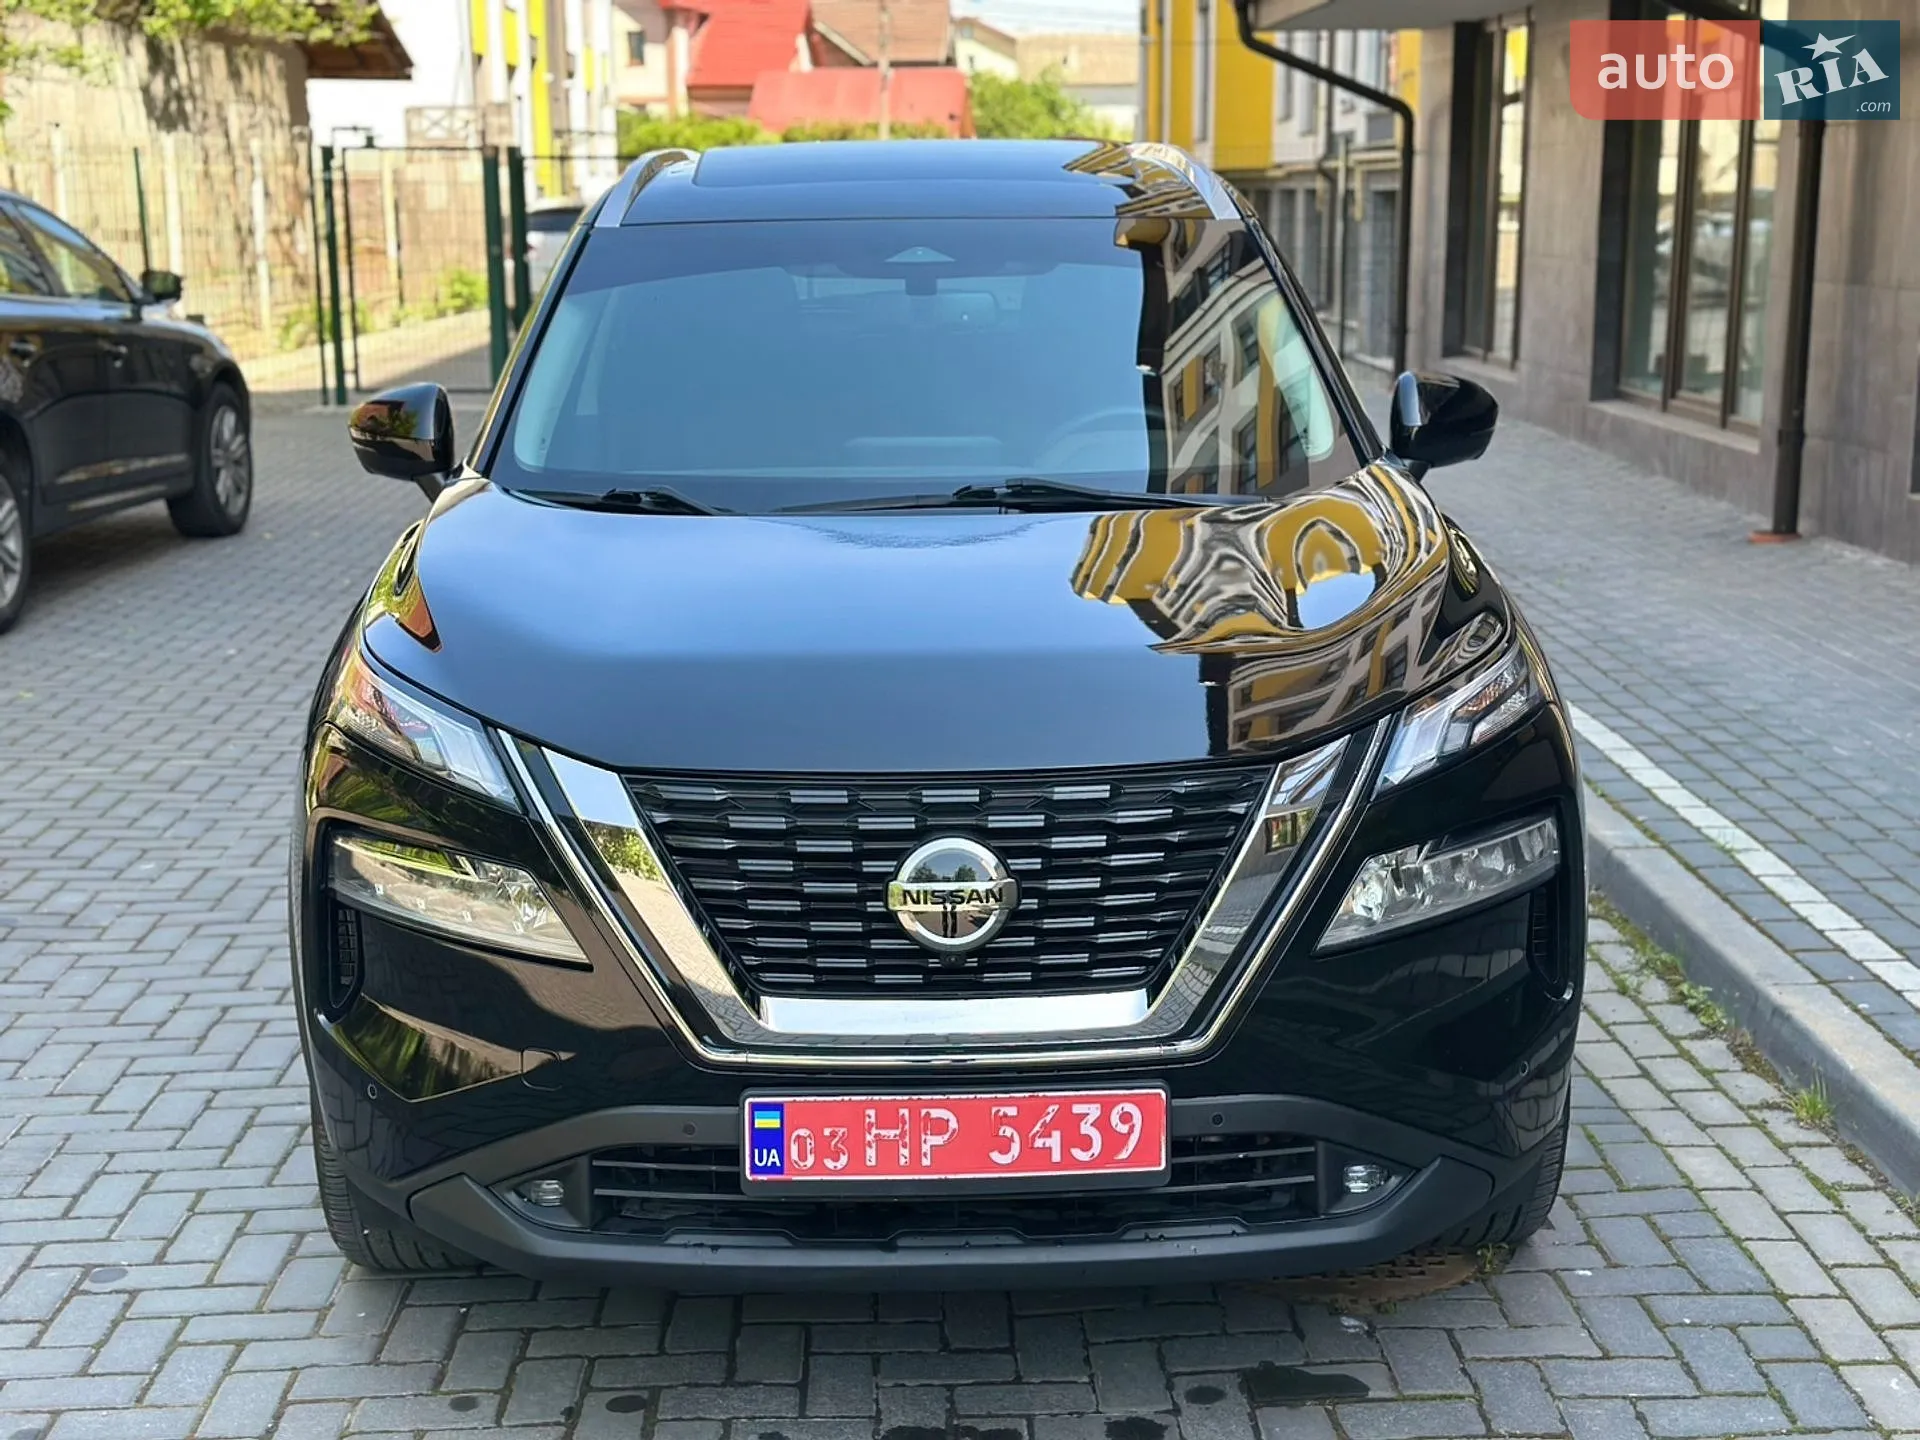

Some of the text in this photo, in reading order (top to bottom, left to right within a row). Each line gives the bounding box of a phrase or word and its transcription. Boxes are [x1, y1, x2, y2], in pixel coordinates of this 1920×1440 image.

[902, 888, 1004, 905] NISSAN
[988, 1102, 1143, 1166] 5439
[754, 1149, 781, 1167] UA
